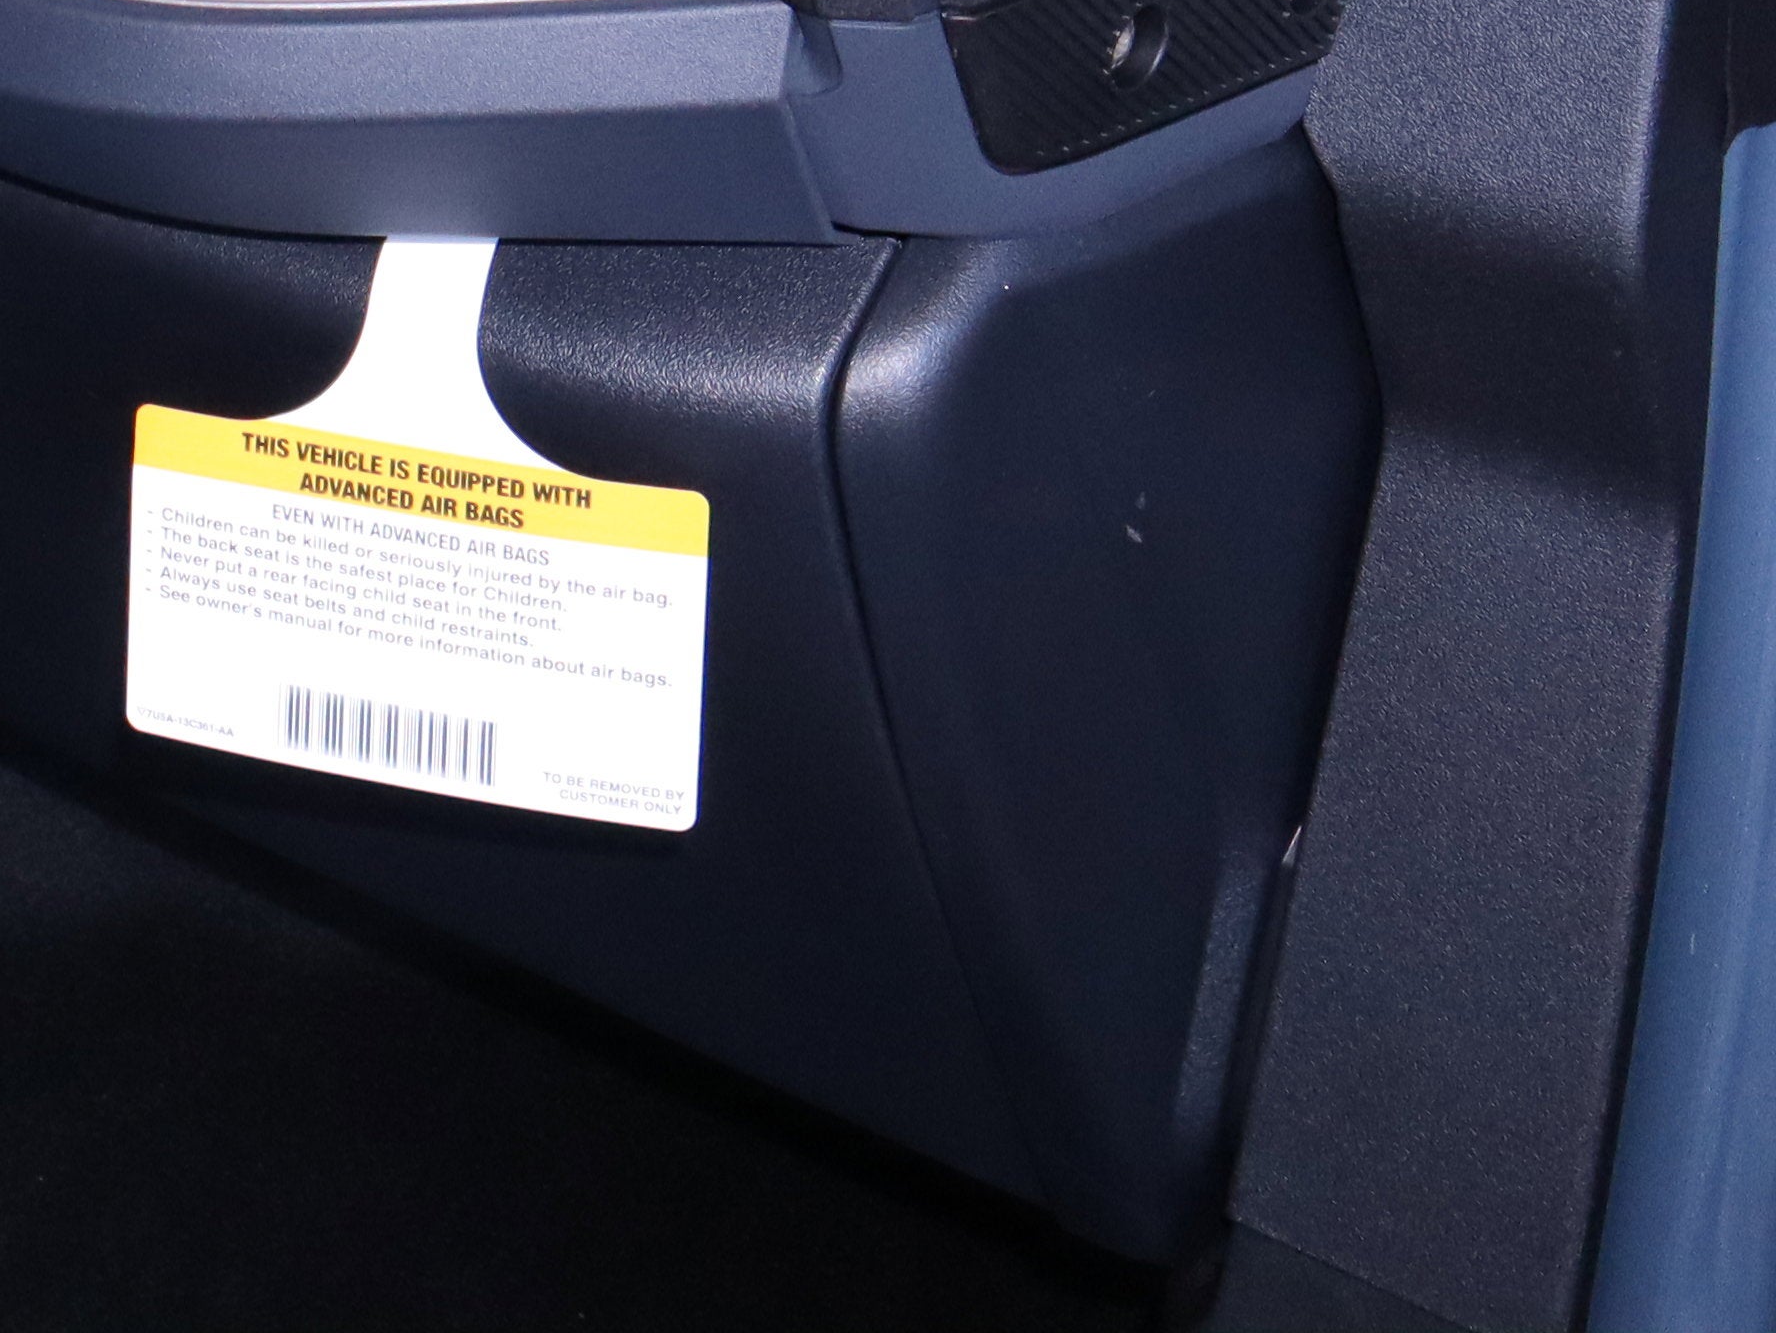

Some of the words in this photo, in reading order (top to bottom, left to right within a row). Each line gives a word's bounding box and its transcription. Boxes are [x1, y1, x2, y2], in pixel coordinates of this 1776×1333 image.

[241, 431, 290, 459] THIS
[296, 441, 383, 476] VEHICLE
[389, 457, 411, 480] IS
[416, 461, 526, 500] EQUIPPED
[532, 480, 592, 509] WITH
[299, 472, 415, 512] ADVANCED
[420, 495, 458, 519] AIR
[464, 501, 525, 530] BAGS
[161, 507, 233, 534] Children
[239, 524, 270, 540] can
[276, 529, 297, 545] be
[303, 532, 349, 555] killed
[355, 545, 373, 559] or
[380, 551, 462, 577] seriously
[468, 564, 532, 588] injured
[539, 574, 560, 593] by
[567, 579, 596, 596] the
[602, 584, 627, 600] air
[633, 586, 673, 608] bag.
[161, 526, 192, 545] The
[198, 533, 238, 554] back
[244, 545, 280, 561] seat
[286, 552, 300, 566] is
[306, 555, 333, 571] the
[339, 561, 392, 583] safest
[398, 571, 447, 593] place
[453, 581, 478, 598] for
[484, 586, 568, 612] Children.
[272, 503, 314, 526] EVEN
[321, 512, 364, 534] WITH
[370, 521, 461, 552] ADVANCED
[467, 540, 496, 558] AIR
[503, 544, 550, 566] BAGS
[160, 547, 209, 568] Never
[215, 558, 243, 576] put
[248, 565, 258, 578] a
[263, 568, 297, 584] rear
[303, 574, 357, 600] facing
[363, 585, 406, 606] child
[412, 597, 450, 614] seat
[456, 601, 472, 616] in
[478, 606, 507, 623] the
[513, 611, 562, 632] front.
[160, 566, 221, 591] Always
[227, 582, 257, 597] use
[263, 588, 299, 606] seat
[305, 596, 347, 615] belts
[353, 604, 386, 622] and
[391, 610, 435, 631] child
[441, 622, 534, 648] restraints.
[159, 584, 191, 603] See
[196, 593, 262, 618] owner's
[268, 608, 332, 631] manual
[338, 621, 362, 637] for
[368, 628, 414, 647] more
[419, 635, 526, 666] information
[531, 655, 585, 675] about
[591, 664, 615, 680] air
[620, 667, 673, 689] bags.
[543, 771, 562, 784] TO
[566, 775, 585, 787] BE
[590, 779, 661, 798] REMOVED
[665, 789, 685, 801] BY
[559, 789, 639, 808] CUSTOMER
[644, 801, 682, 815] ONLY
